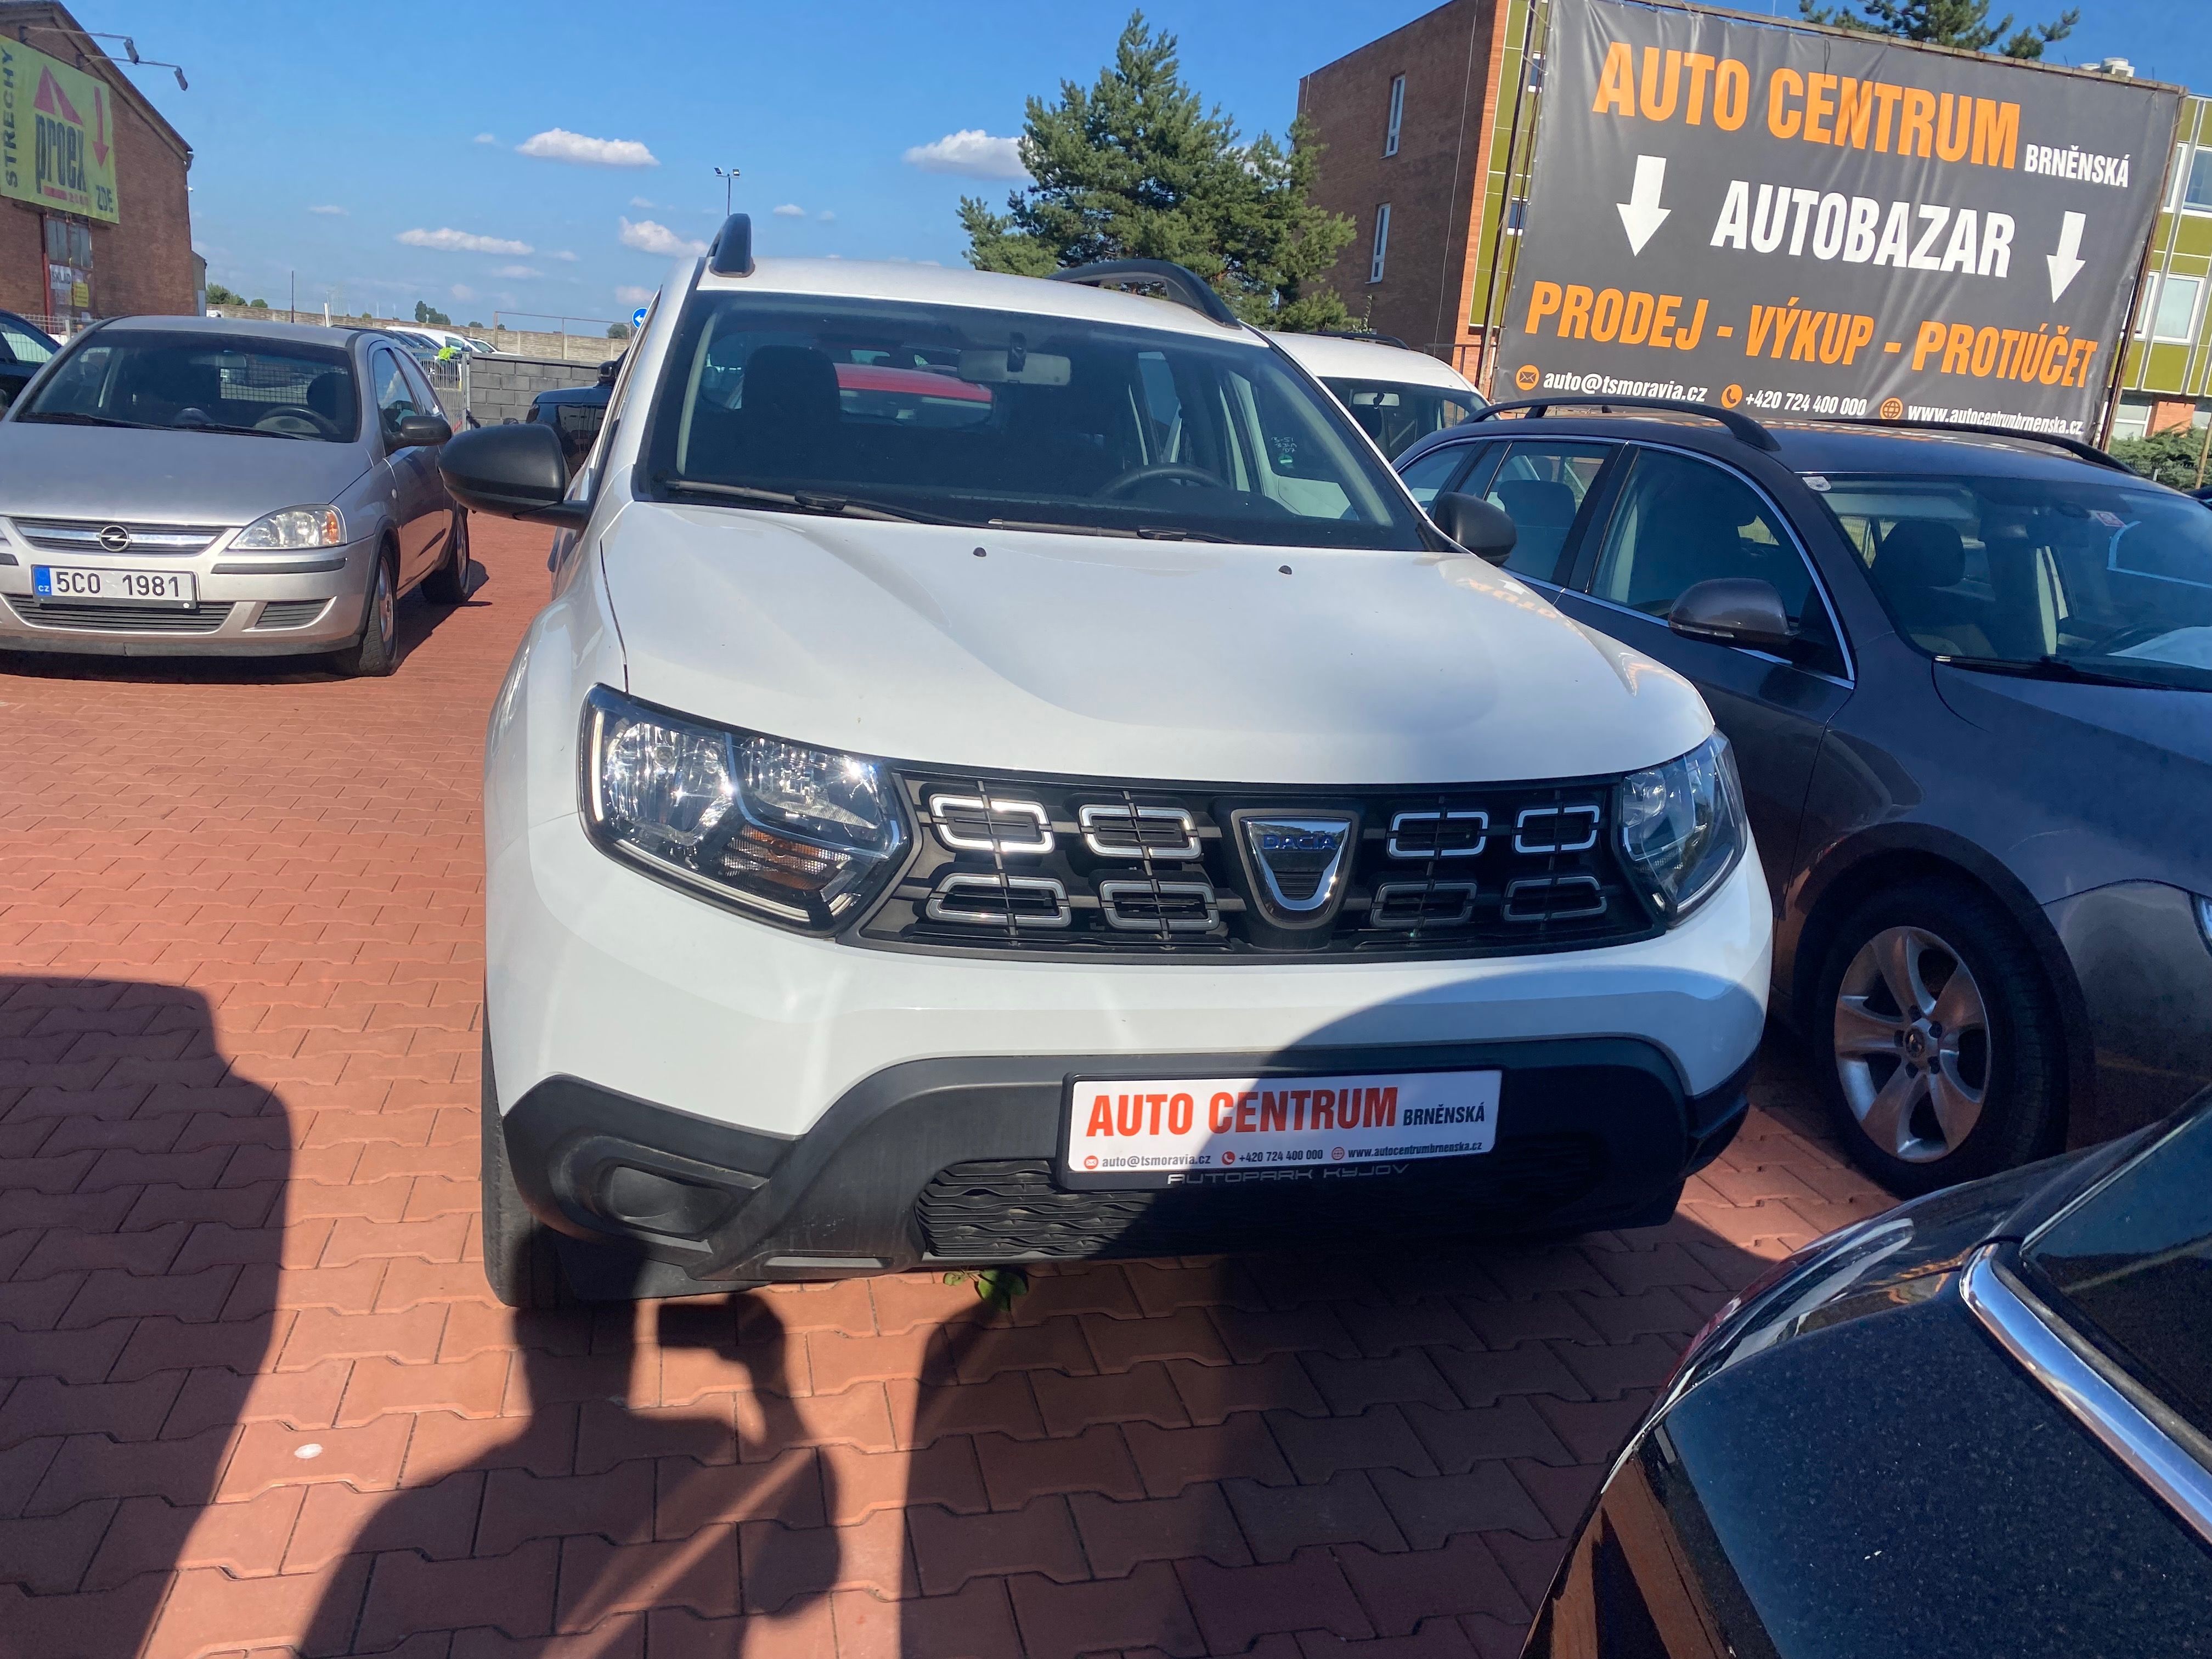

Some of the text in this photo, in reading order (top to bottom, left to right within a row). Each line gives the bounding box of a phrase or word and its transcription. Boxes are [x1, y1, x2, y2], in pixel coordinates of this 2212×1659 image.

[1593, 42, 2129, 188] AUTO CENTRUM BRNĚNSKÁ
[95, 185, 113, 213] ZDE
[1710, 180, 2016, 278] AUTOBAZAR
[1525, 281, 1709, 350] PRODEJ
[1746, 297, 1874, 365] VÝKUP
[1912, 322, 2098, 387] PROTIÚČET
[1543, 372, 1708, 402] auto@tsmoravia.cz
[1746, 388, 1867, 416] +420 724 400 000
[1908, 405, 2084, 435] www.autocentrumbrnenska.cz
[122, 575, 179, 597] 1981
[1263, 834, 1337, 850] DACIA
[1086, 1087, 1485, 1137] AUTO CENTRUM BRNĚNSKÁ
[1102, 1154, 1211, 1168] auto@tsmoravia.cz
[1239, 1149, 1323, 1163] +420 724 400 000
[1348, 1141, 1482, 1158] www.autocentrumbrnenska.cz
[1167, 1164, 1409, 1185] AUTOPARK KYJOV
